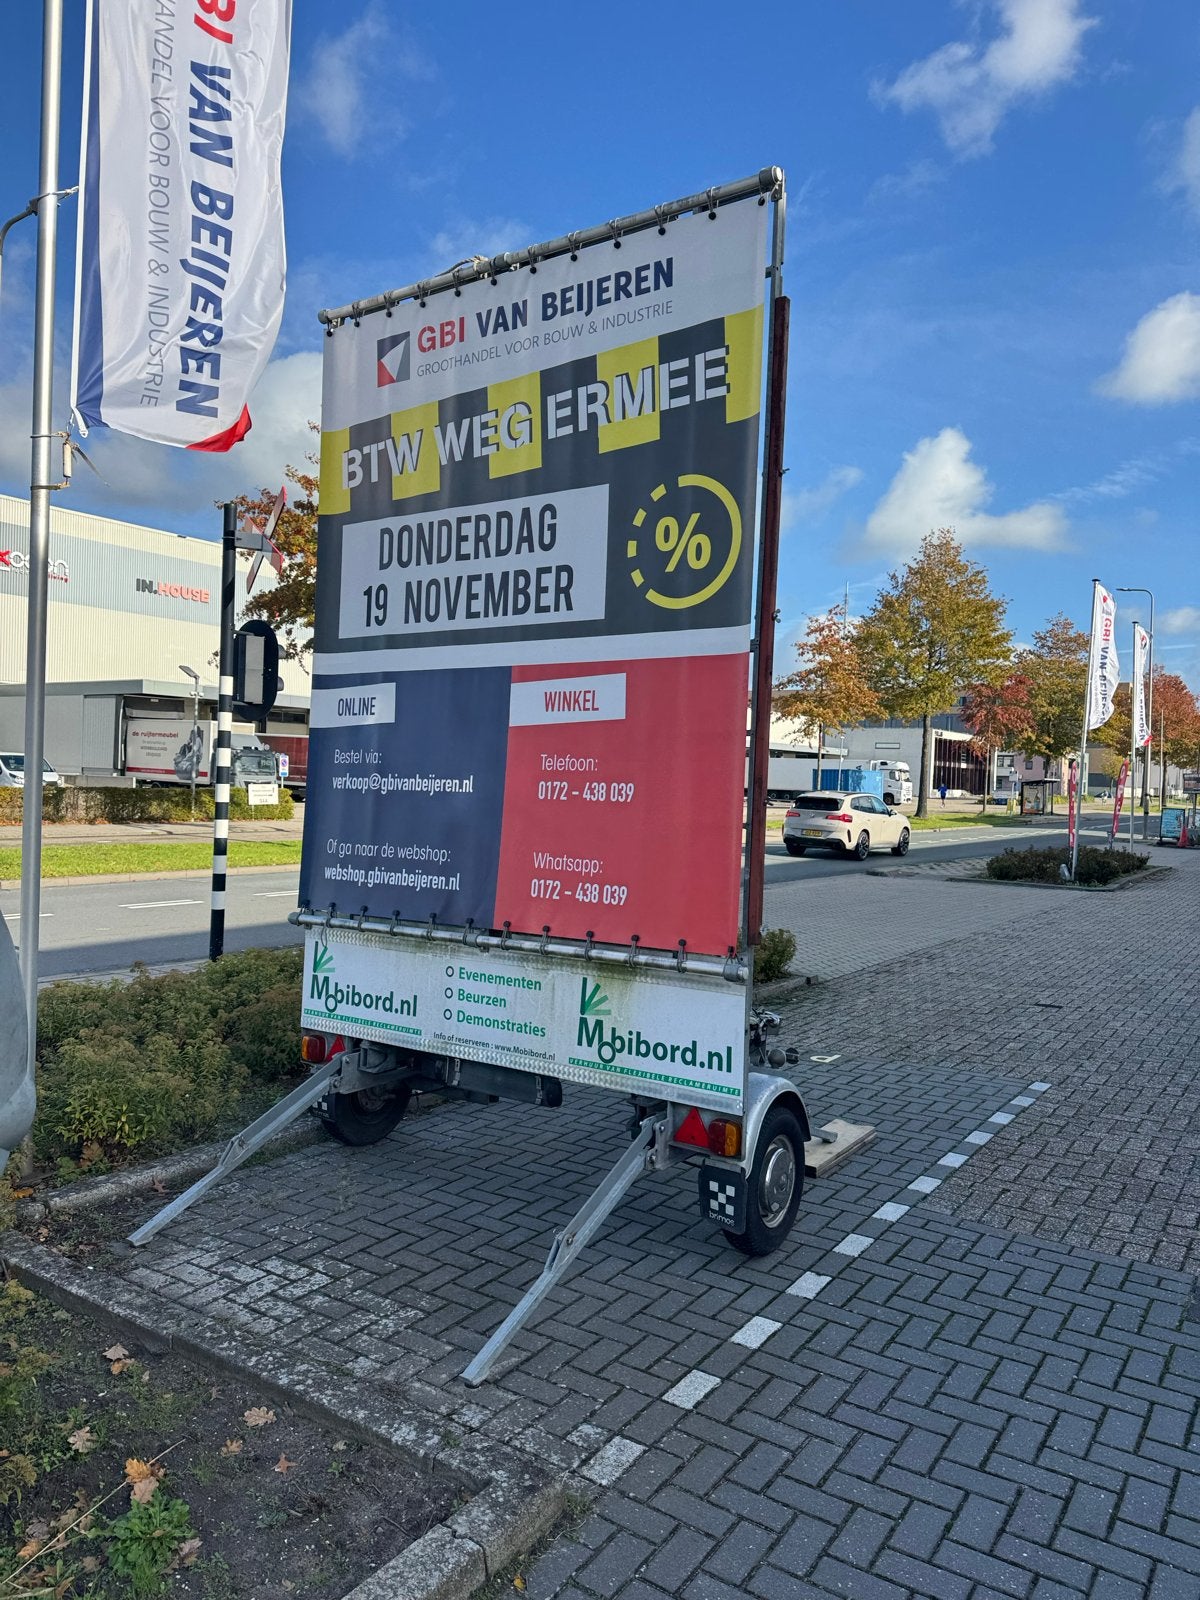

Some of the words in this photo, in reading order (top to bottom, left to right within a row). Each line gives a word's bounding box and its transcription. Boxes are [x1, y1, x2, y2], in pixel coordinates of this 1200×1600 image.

[188, 60, 233, 168] VAN
[148, 96, 171, 166] VOOR
[148, 173, 170, 255] BOUW
[148, 259, 169, 277] &
[176, 180, 235, 419] BEIJEREN
[417, 316, 465, 353] GBI
[476, 299, 528, 338] VAN
[541, 257, 673, 322] BEIJEREN
[140, 286, 170, 407] INDUSTRIE
[417, 346, 501, 377] GROOTHANDEL
[504, 335, 539, 355] VOOR
[543, 323, 584, 345] BOUW
[588, 320, 598, 335] &
[602, 300, 673, 331] INDUSTRIE
[342, 428, 424, 490] BTW
[433, 401, 533, 466] WEG
[547, 344, 731, 440] ERMEE
[379, 503, 557, 571] DONDERDAG
[136, 578, 209, 604] IN.HOUSE
[363, 584, 388, 627] 19
[404, 564, 574, 624] NOVEMBER
[337, 697, 376, 717] ONLINE
[544, 690, 599, 712] WINKEL
[334, 749, 362, 764] Bestel
[365, 750, 382, 764] via:
[540, 754, 598, 771] Telefoon:
[332, 772, 474, 796] verkoop@gbivanbeijeren.nl
[538, 781, 568, 800] 0172
[583, 782, 606, 801] 438
[610, 782, 635, 802] 039
[327, 839, 338, 854] Of
[338, 843, 352, 858] ga
[354, 843, 378, 857] naar
[381, 842, 394, 858] de
[397, 844, 451, 864] webshop:
[533, 852, 603, 877] Whatsapp:
[324, 864, 460, 891] webshop.gbivanbeijeren.nl
[530, 878, 561, 900] 0172
[575, 882, 599, 904] 438
[603, 885, 628, 906] 039
[458, 967, 542, 991] Evenementen
[310, 974, 418, 1017] Mobibord.nl
[458, 989, 507, 1008] Beurzen
[456, 1010, 546, 1037] Demonstraties
[433, 1032, 446, 1041] Info
[455, 1037, 490, 1048] reserveren
[495, 1045, 556, 1061] www.Mobibord.nl
[577, 1017, 732, 1073] Mobibord.nl
[569, 1058, 604, 1070] VERHUUR
[606, 1065, 621, 1073] VAN
[623, 1069, 665, 1082] FLEXIBELE
[668, 1077, 739, 1096] RECLAMERUIMTE
[709, 1210, 735, 1226] brimos
